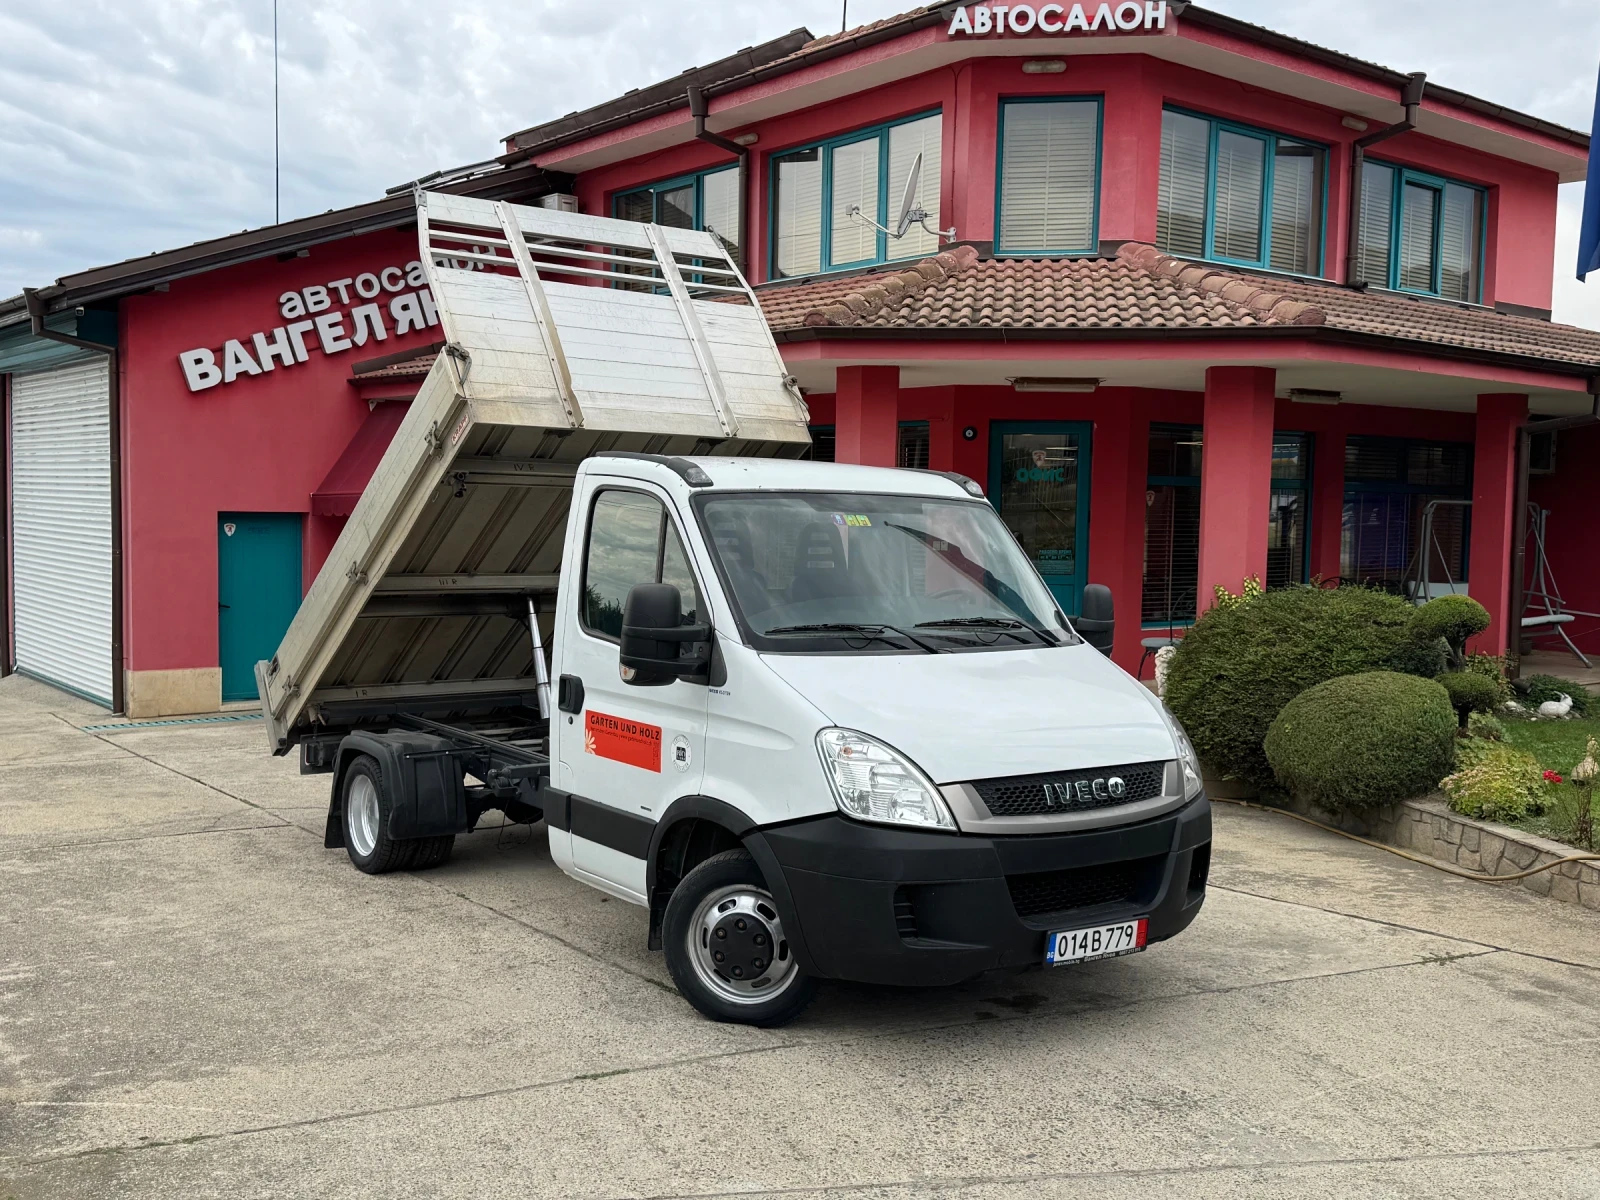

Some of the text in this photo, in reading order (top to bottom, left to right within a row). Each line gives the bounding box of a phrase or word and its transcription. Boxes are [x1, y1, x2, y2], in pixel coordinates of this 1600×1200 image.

[947, 1, 1167, 35] АВТОСАЛОН
[178, 303, 388, 392] ВАНГЕЛ
[590, 715, 619, 730] GARTEN
[620, 723, 637, 735] UND
[639, 727, 660, 740] HOLZ
[1043, 777, 1126, 805] IVECO
[1046, 951, 1055, 959] BG
[1058, 925, 1134, 957] 014B779
